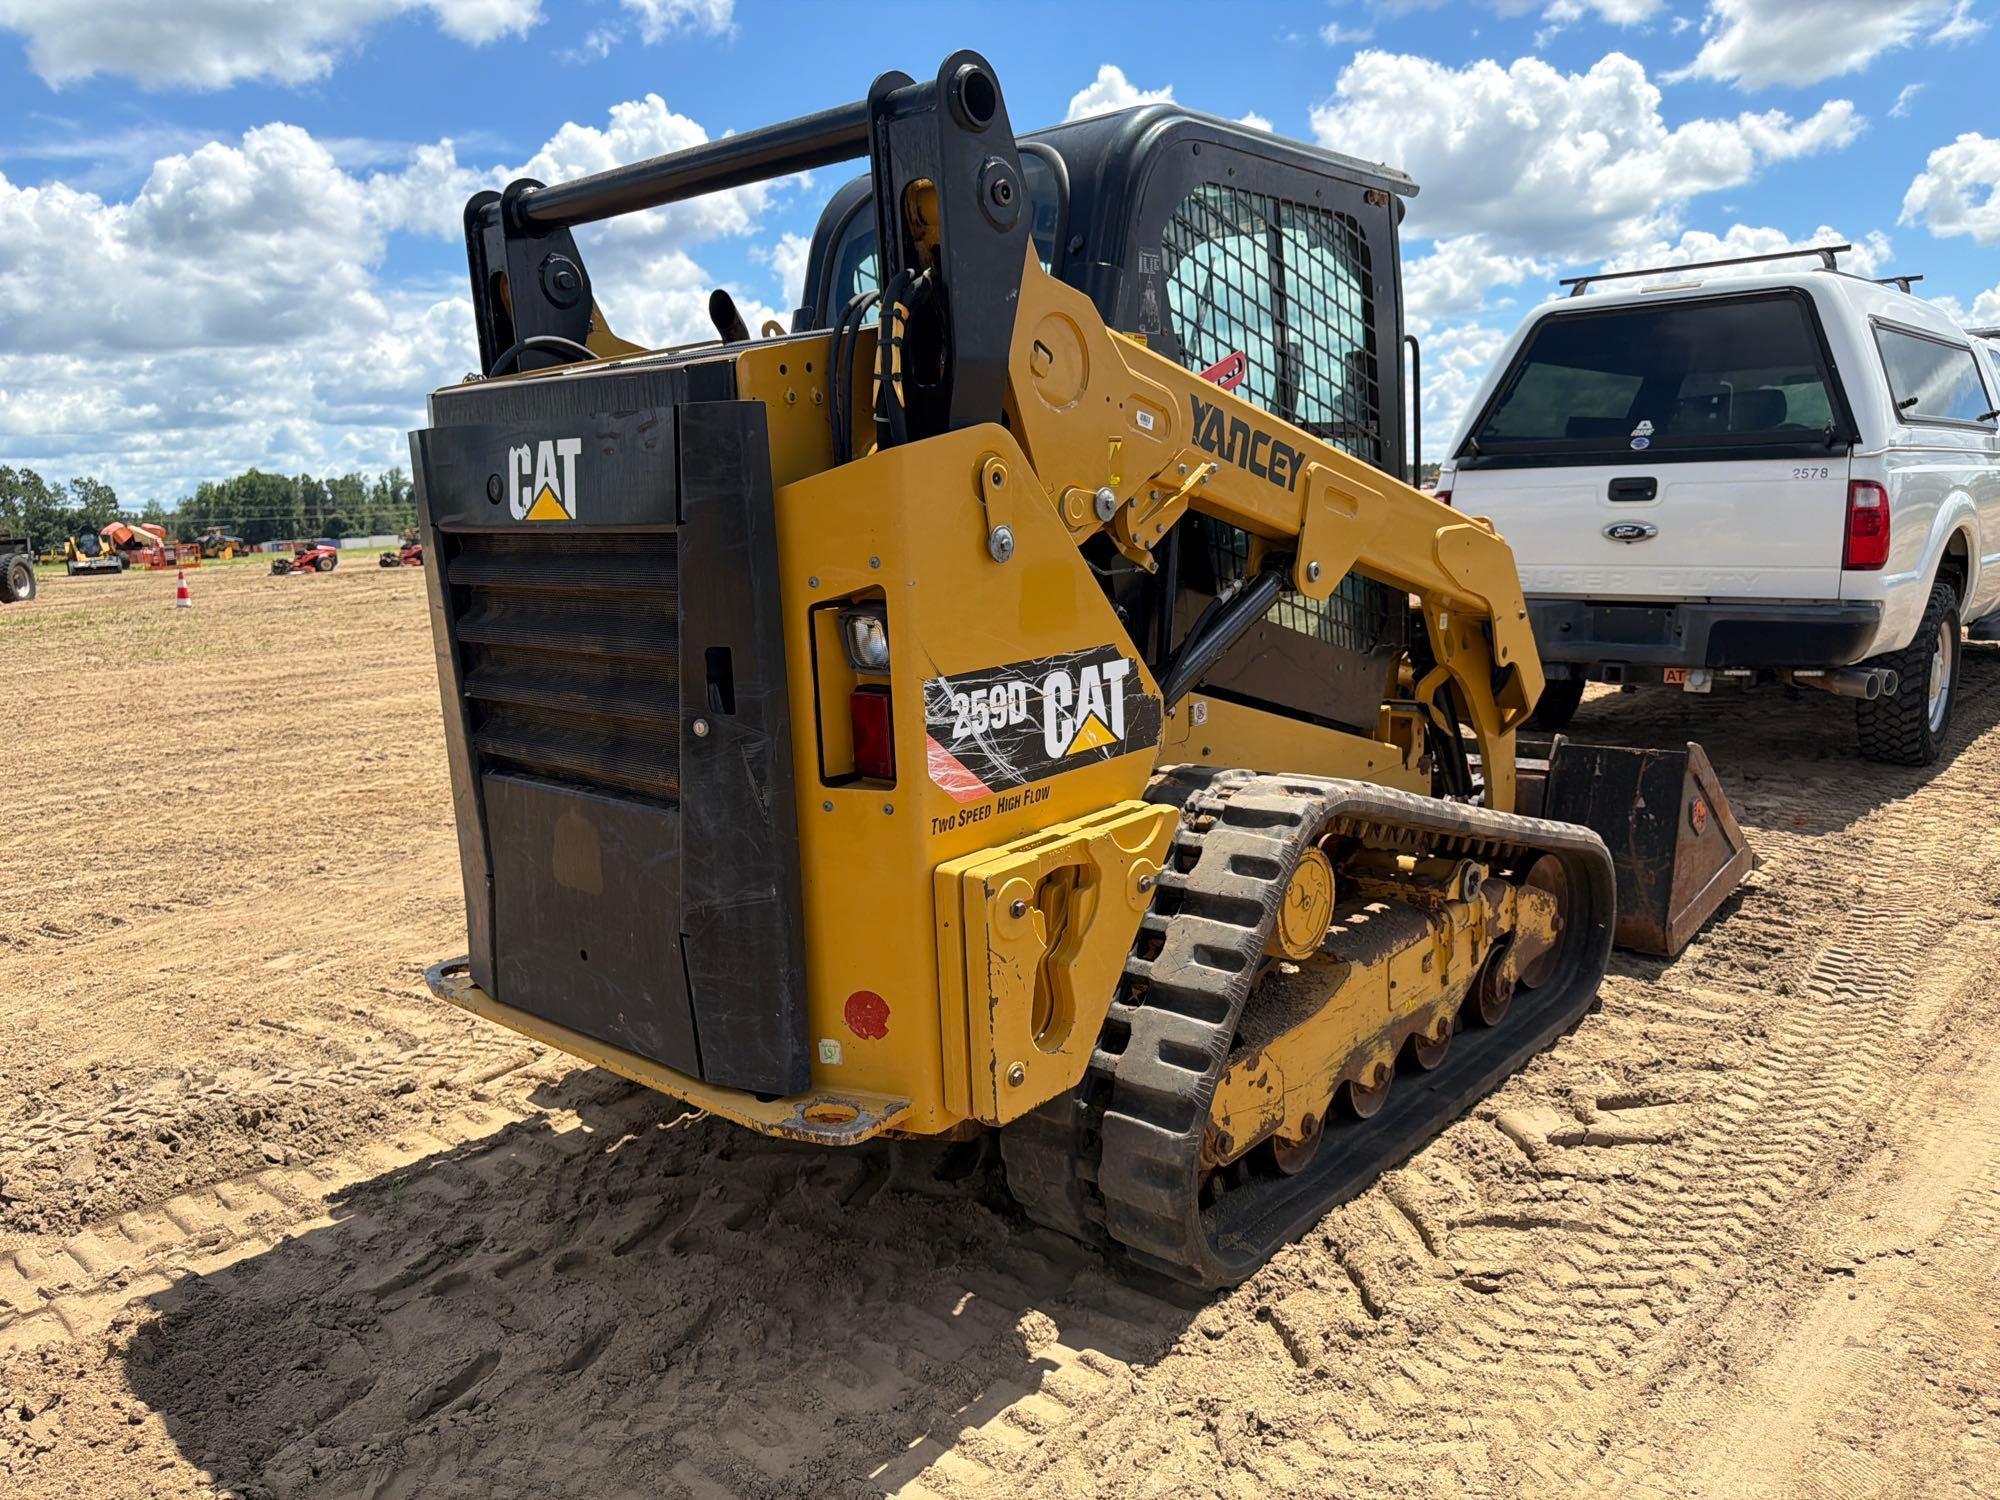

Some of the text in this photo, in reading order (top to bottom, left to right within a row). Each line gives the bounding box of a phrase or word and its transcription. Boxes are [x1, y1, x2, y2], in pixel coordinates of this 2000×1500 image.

[1190, 393, 1306, 493] YANCEY
[1792, 467, 1829, 479] 2578
[508, 438, 582, 521] CAT
[1656, 572, 1761, 592] DUTY
[951, 658, 1130, 759] 259D CAT
[931, 785, 1051, 835] TWO SPEED HIGH FLOW
